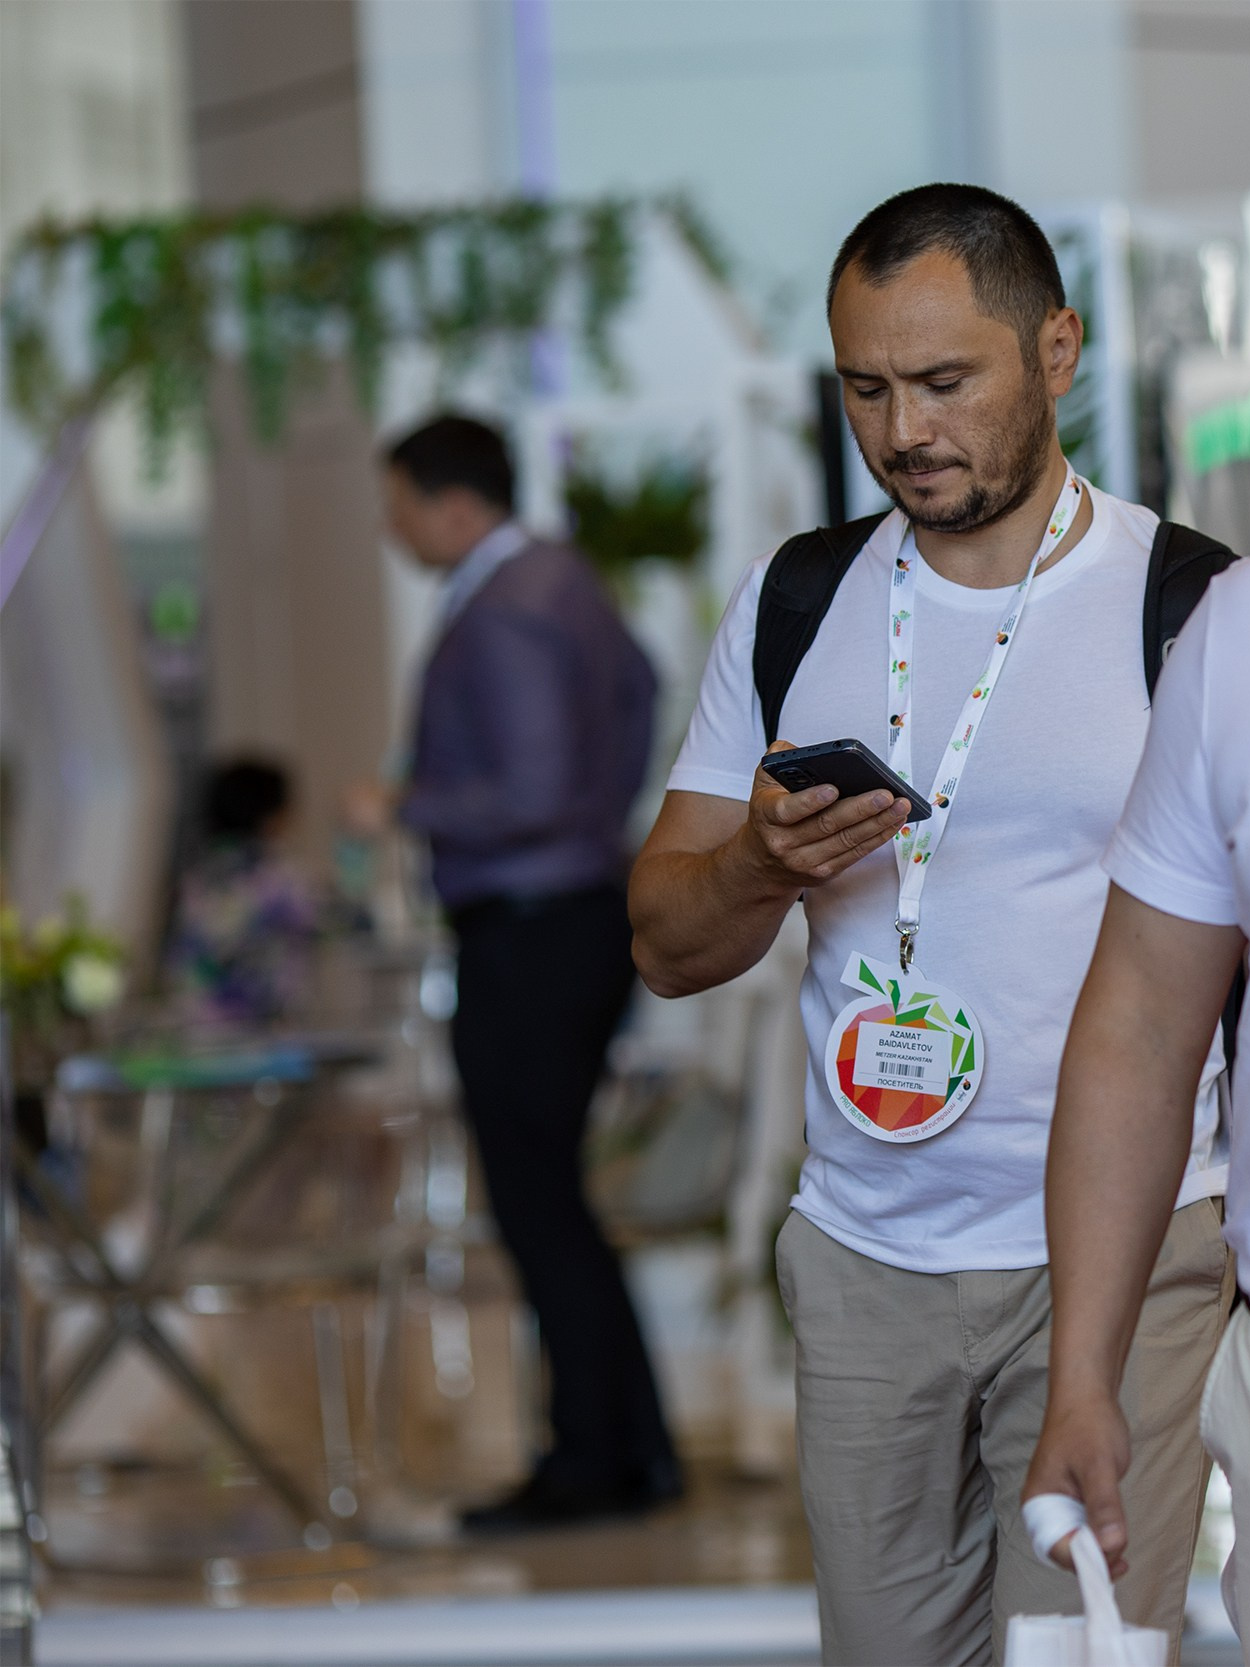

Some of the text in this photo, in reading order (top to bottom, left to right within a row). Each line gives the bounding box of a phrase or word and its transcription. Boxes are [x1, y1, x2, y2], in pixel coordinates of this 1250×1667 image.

[889, 1030, 922, 1040] AZAMAT
[878, 1038, 933, 1052] BAIDAVLETOV
[897, 1054, 933, 1064] KAZAKHSTAN
[877, 1078, 924, 1091] ПОСЕТИТЕЛЬ
[893, 1126, 919, 1138] Спонсор
